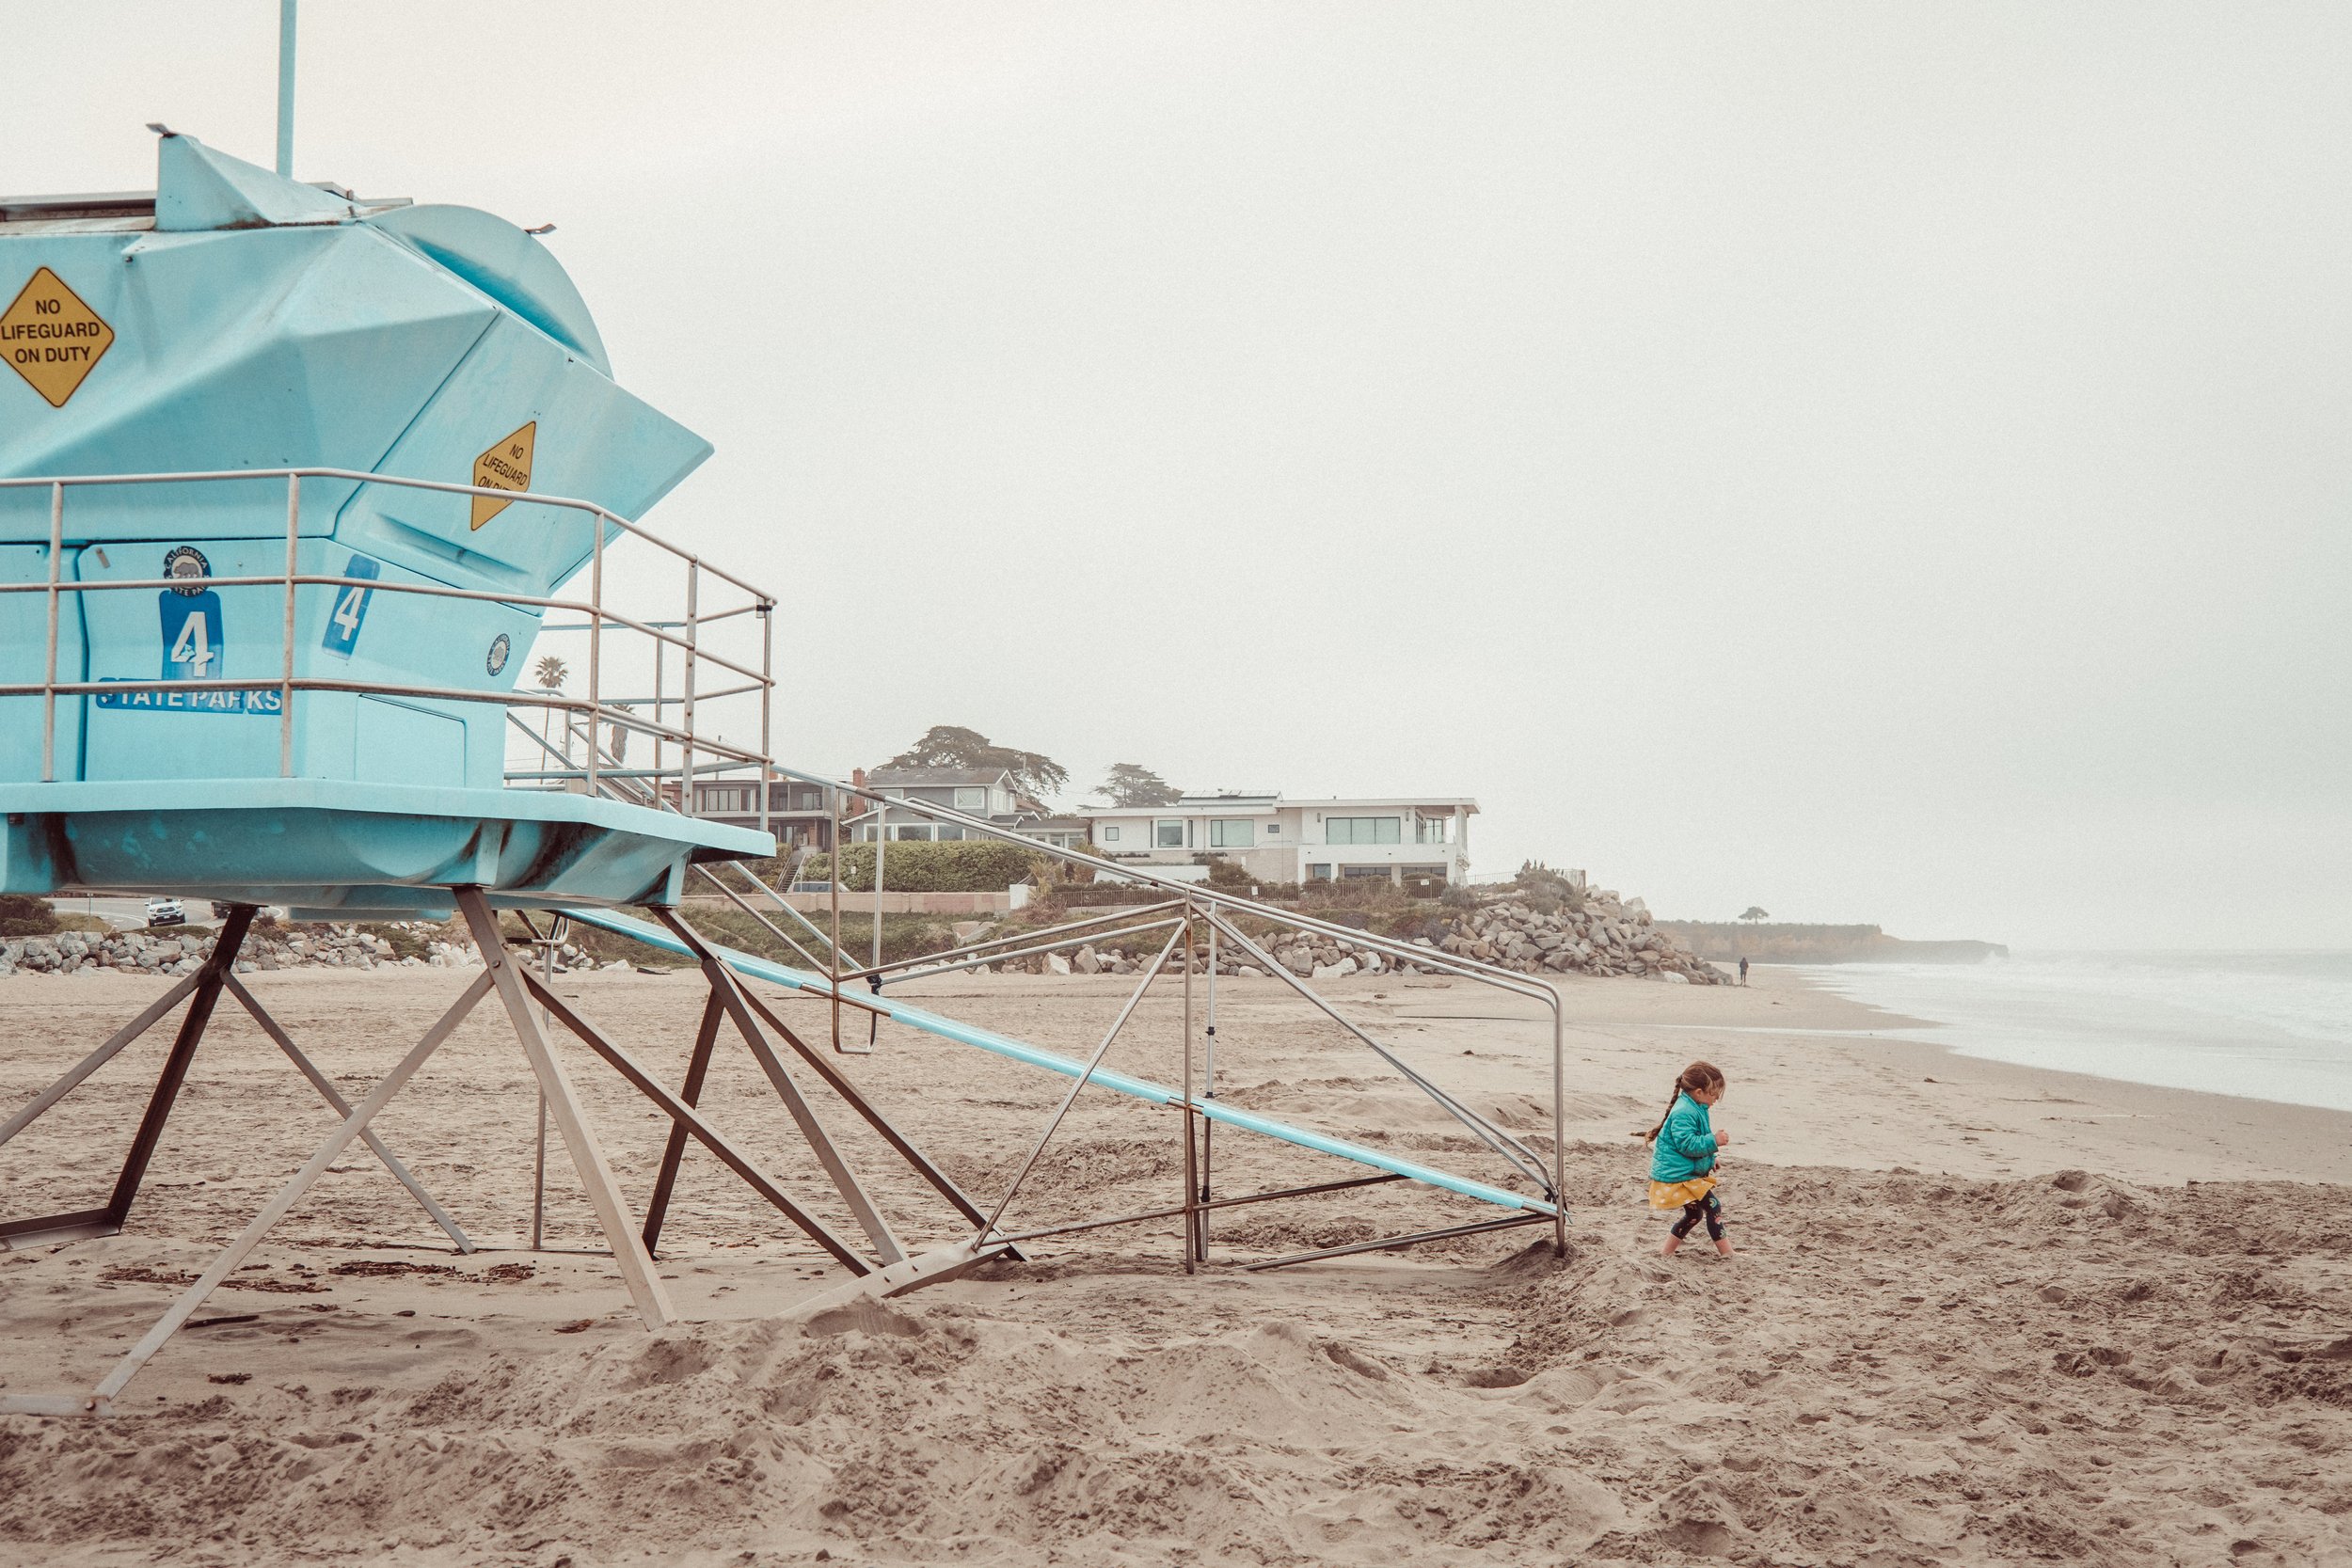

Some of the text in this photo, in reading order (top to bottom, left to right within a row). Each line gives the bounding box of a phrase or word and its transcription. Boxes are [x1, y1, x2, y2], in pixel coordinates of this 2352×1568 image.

[35, 299, 61, 315] NO
[1, 322, 101, 340] LIFEGUARD
[15, 346, 90, 363] ON DUTY
[509, 444, 524, 459] NO
[483, 453, 528, 485] LIFEGUARD
[165, 547, 208, 569] CALIFORNIA
[333, 587, 366, 641] 4
[171, 611, 215, 677] 4
